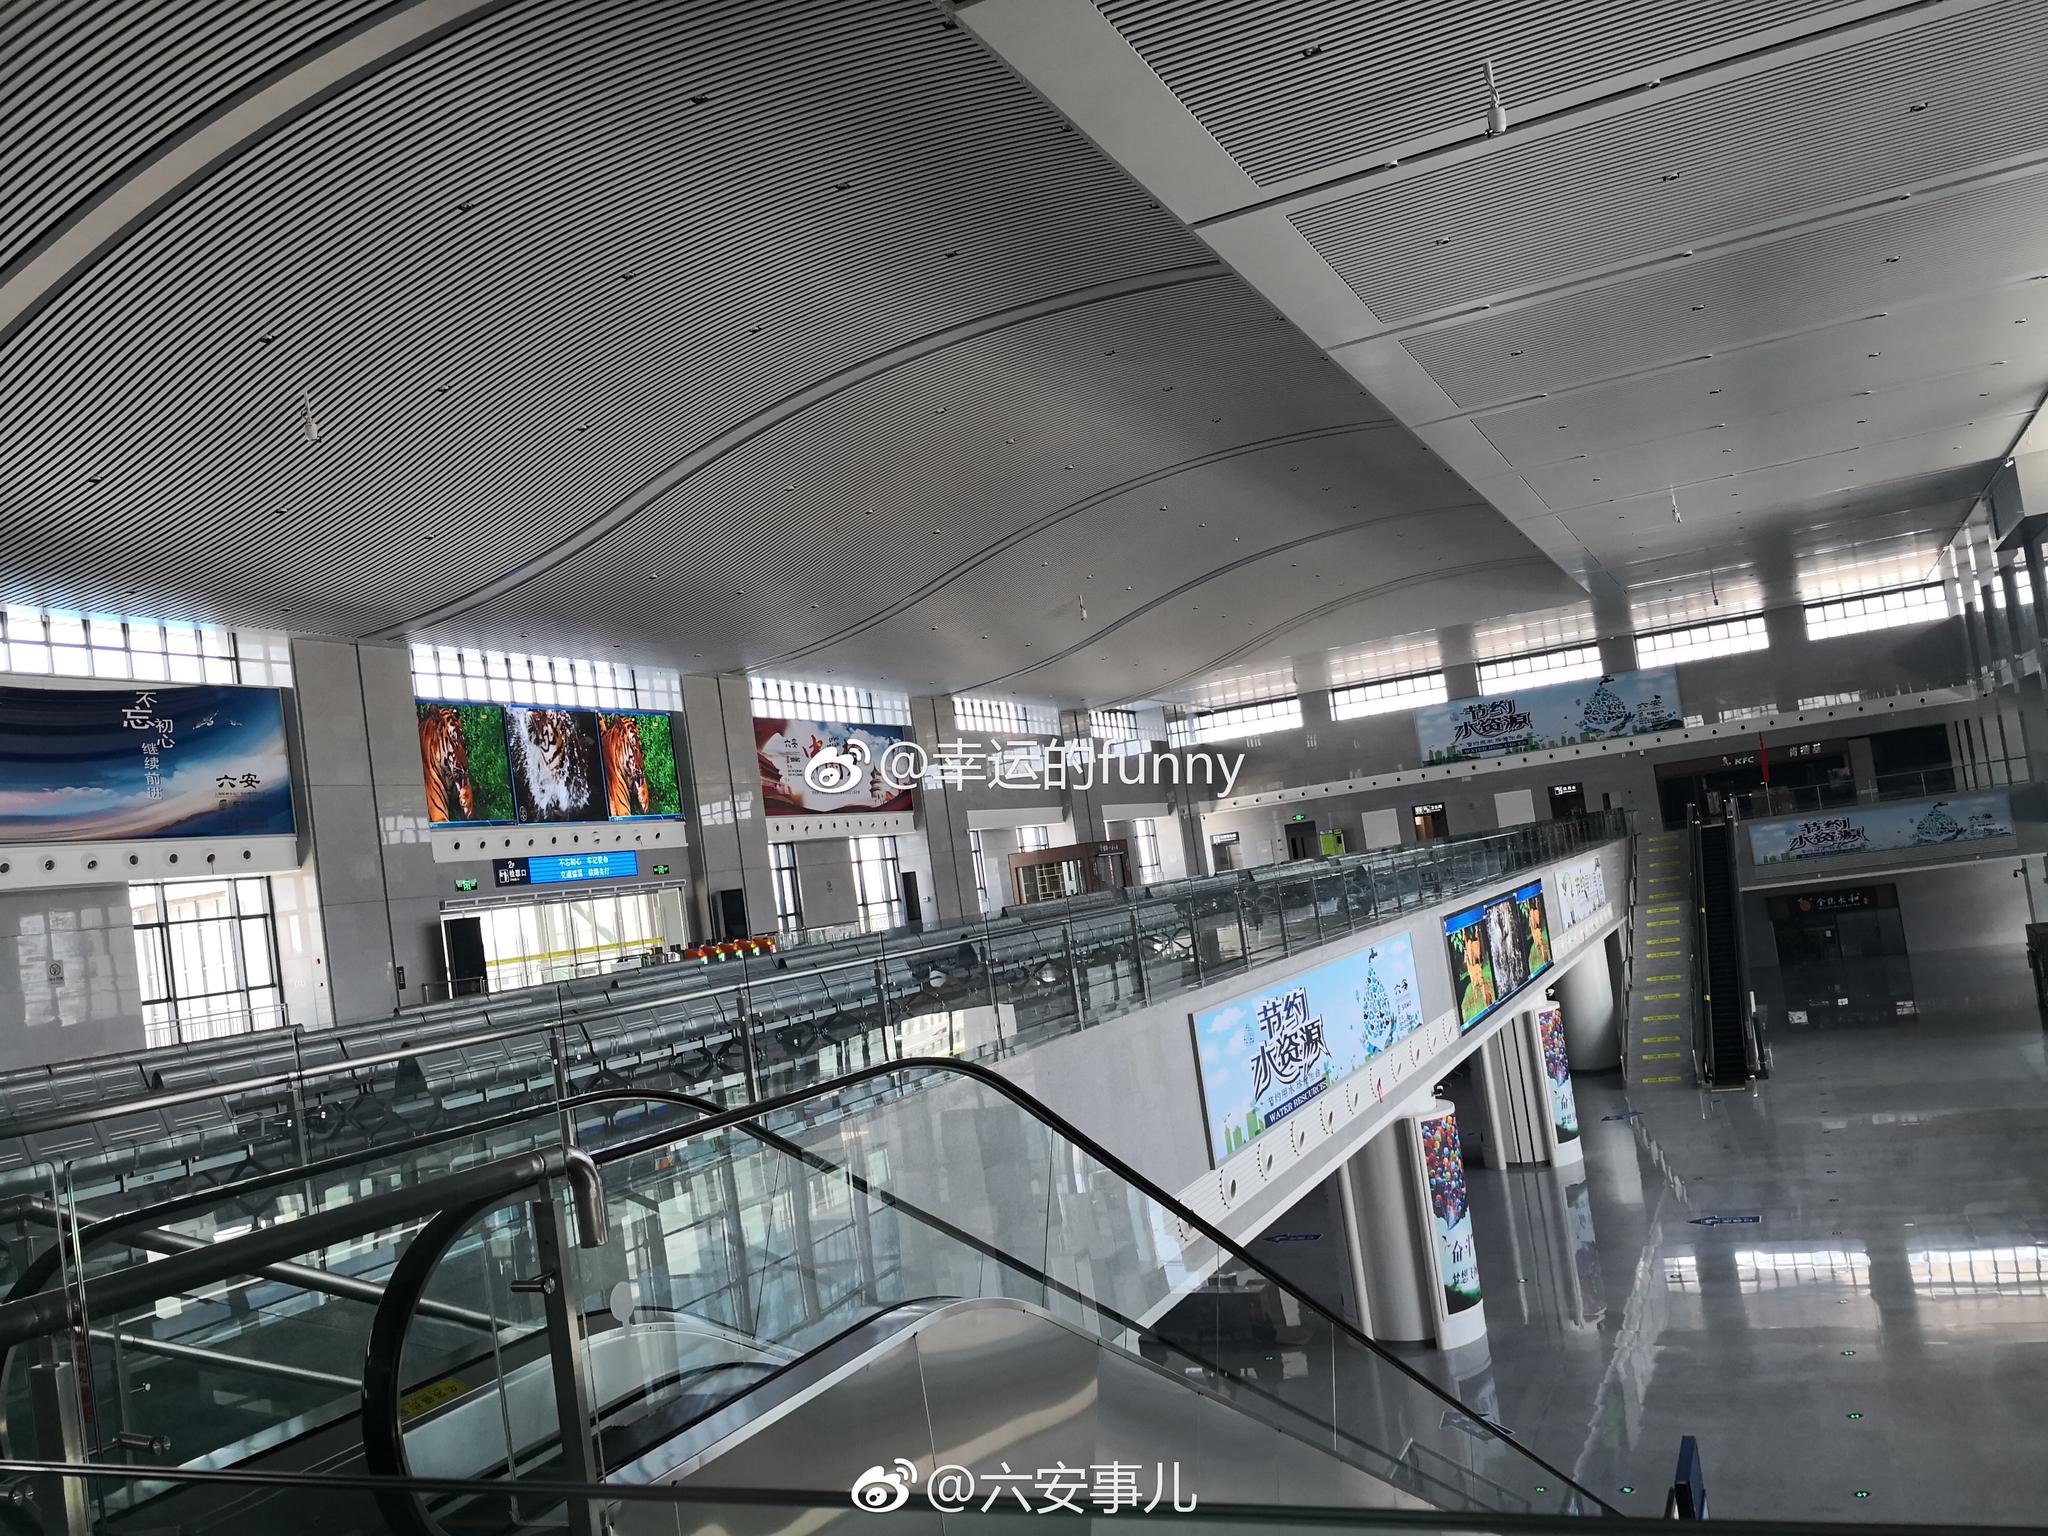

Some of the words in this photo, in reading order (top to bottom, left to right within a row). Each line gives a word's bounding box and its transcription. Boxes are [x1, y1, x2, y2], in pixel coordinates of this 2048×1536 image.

[1735, 756, 1754, 765] KFC
[215, 773, 261, 789] 六安
[1258, 987, 1309, 1040] 节约
[1251, 1014, 1332, 1104] 水资源
[1269, 1102, 1293, 1123] WATER
